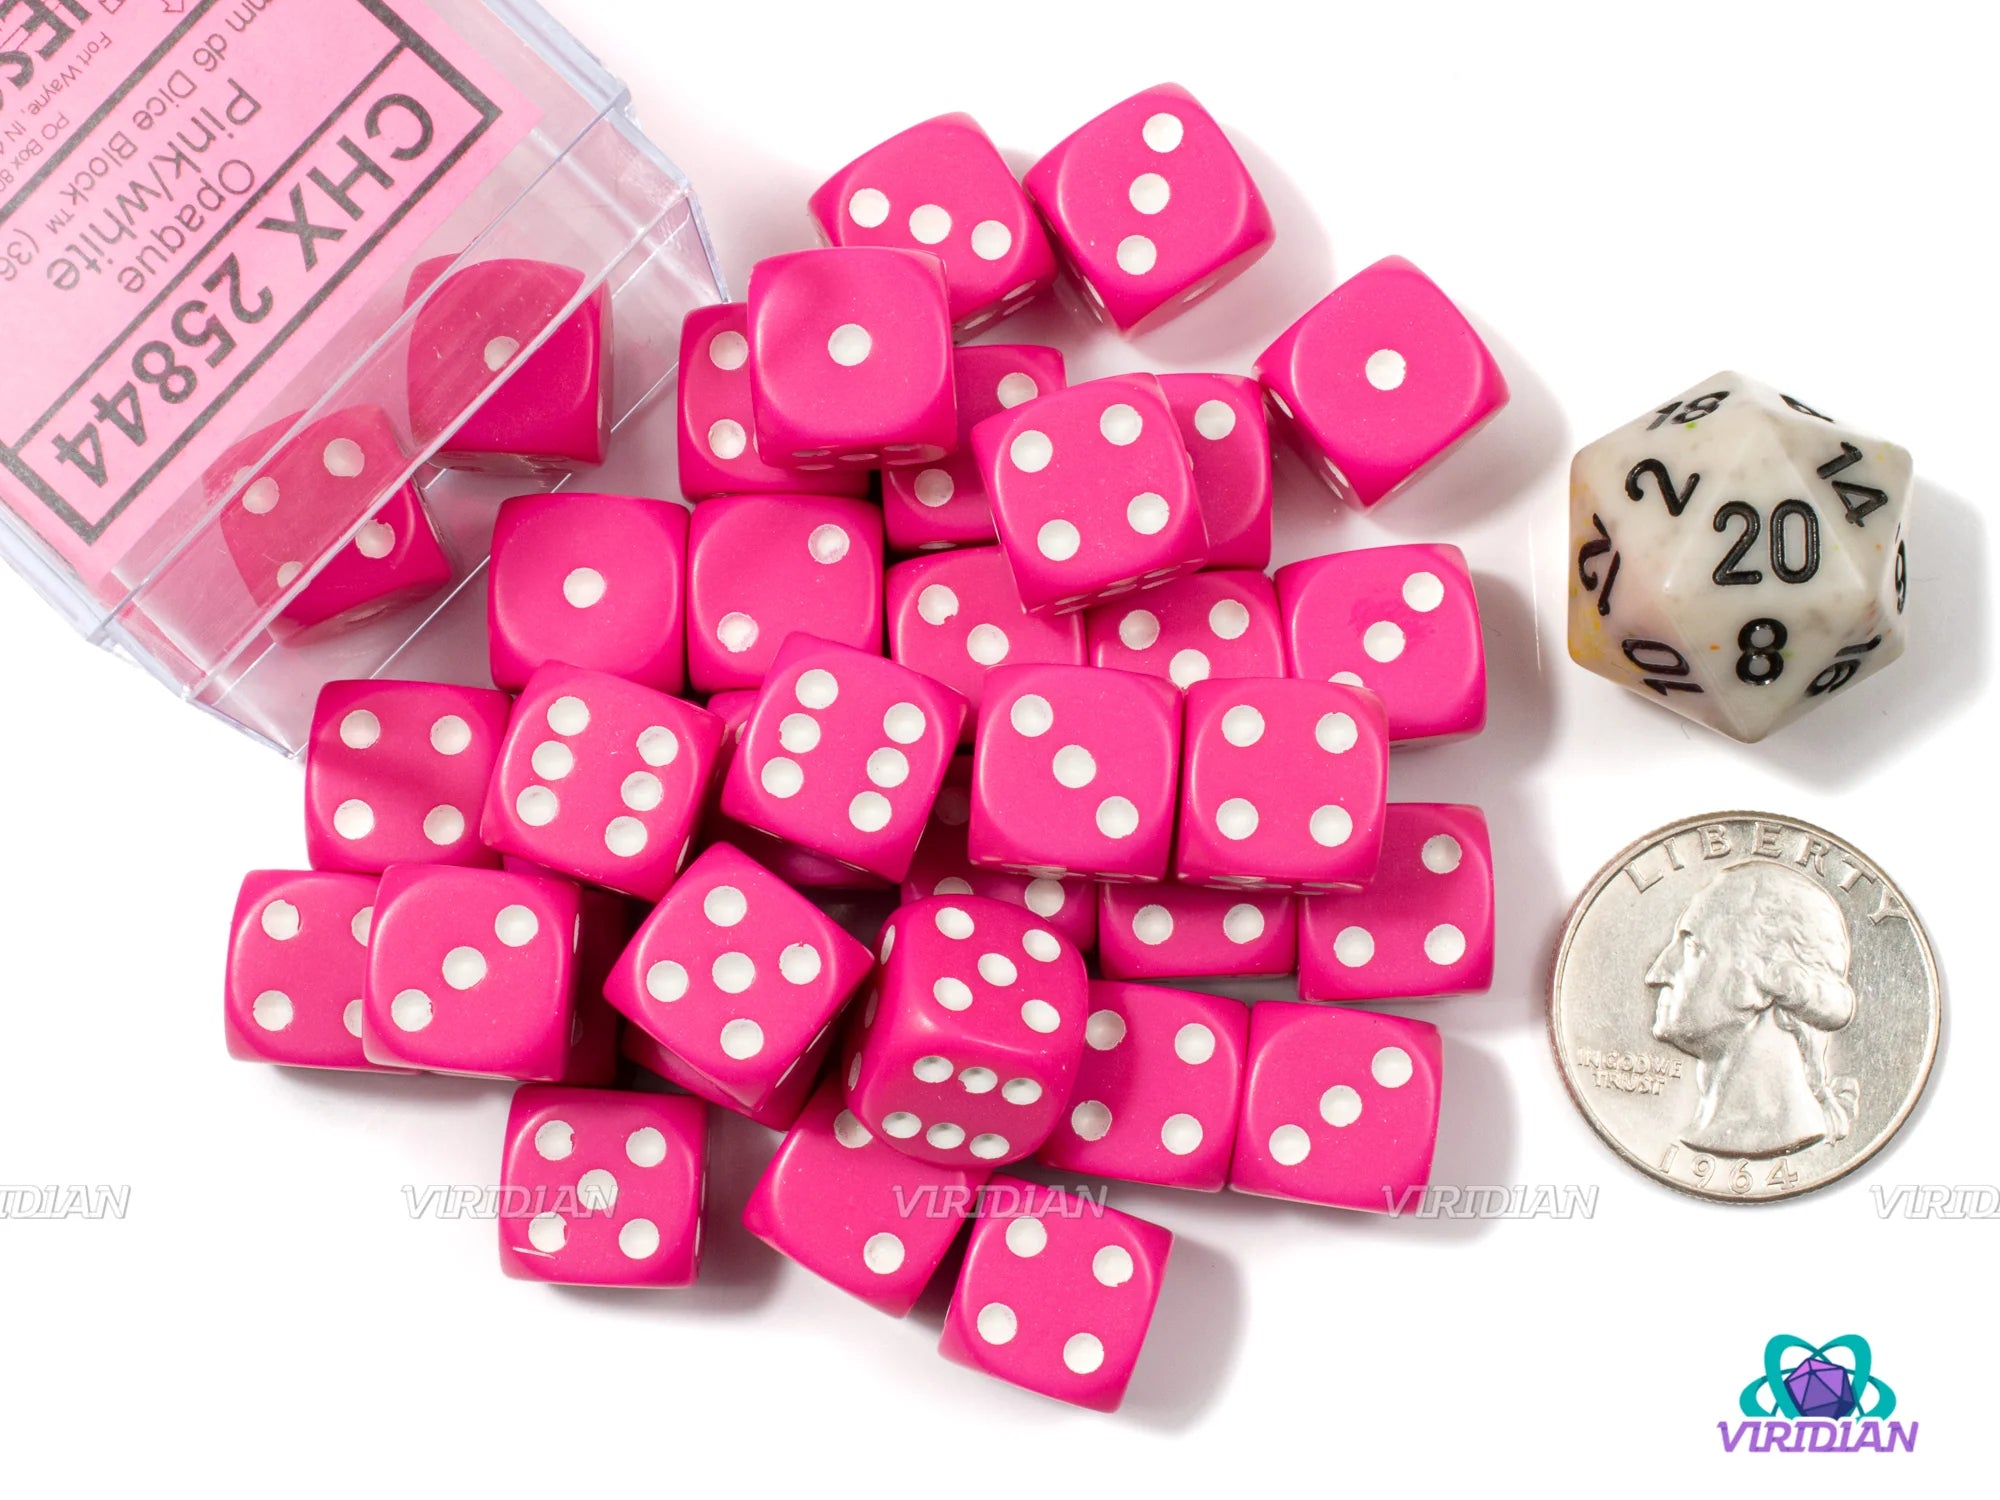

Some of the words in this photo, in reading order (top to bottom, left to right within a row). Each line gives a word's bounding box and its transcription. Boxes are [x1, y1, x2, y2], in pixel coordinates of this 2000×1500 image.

[75, 32, 113, 66] Fort
[193, 33, 229, 72] d6
[20, 65, 83, 115] Wayne,
[132, 69, 198, 130] Dice
[4, 120, 27, 143] IN
[14, 139, 45, 171] Box
[41, 112, 70, 140] PO
[46, 76, 263, 292] Pink/white
[257, 91, 436, 270] CHX
[117, 159, 255, 293] Opaque
[50, 252, 274, 489] 25844
[1624, 457, 1701, 517] 2
[1816, 441, 1889, 528] 14
[1712, 498, 1821, 586] 20
[1622, 638, 1705, 696] 10
[1736, 617, 1788, 687] 8
[1624, 820, 1912, 926] LIBERTY
[1591, 1072, 1666, 1096] TRUST
[1604, 1051, 1651, 1075] GOD
[1652, 1056, 1682, 1079] WE
[1657, 1142, 1799, 1194] 1964
